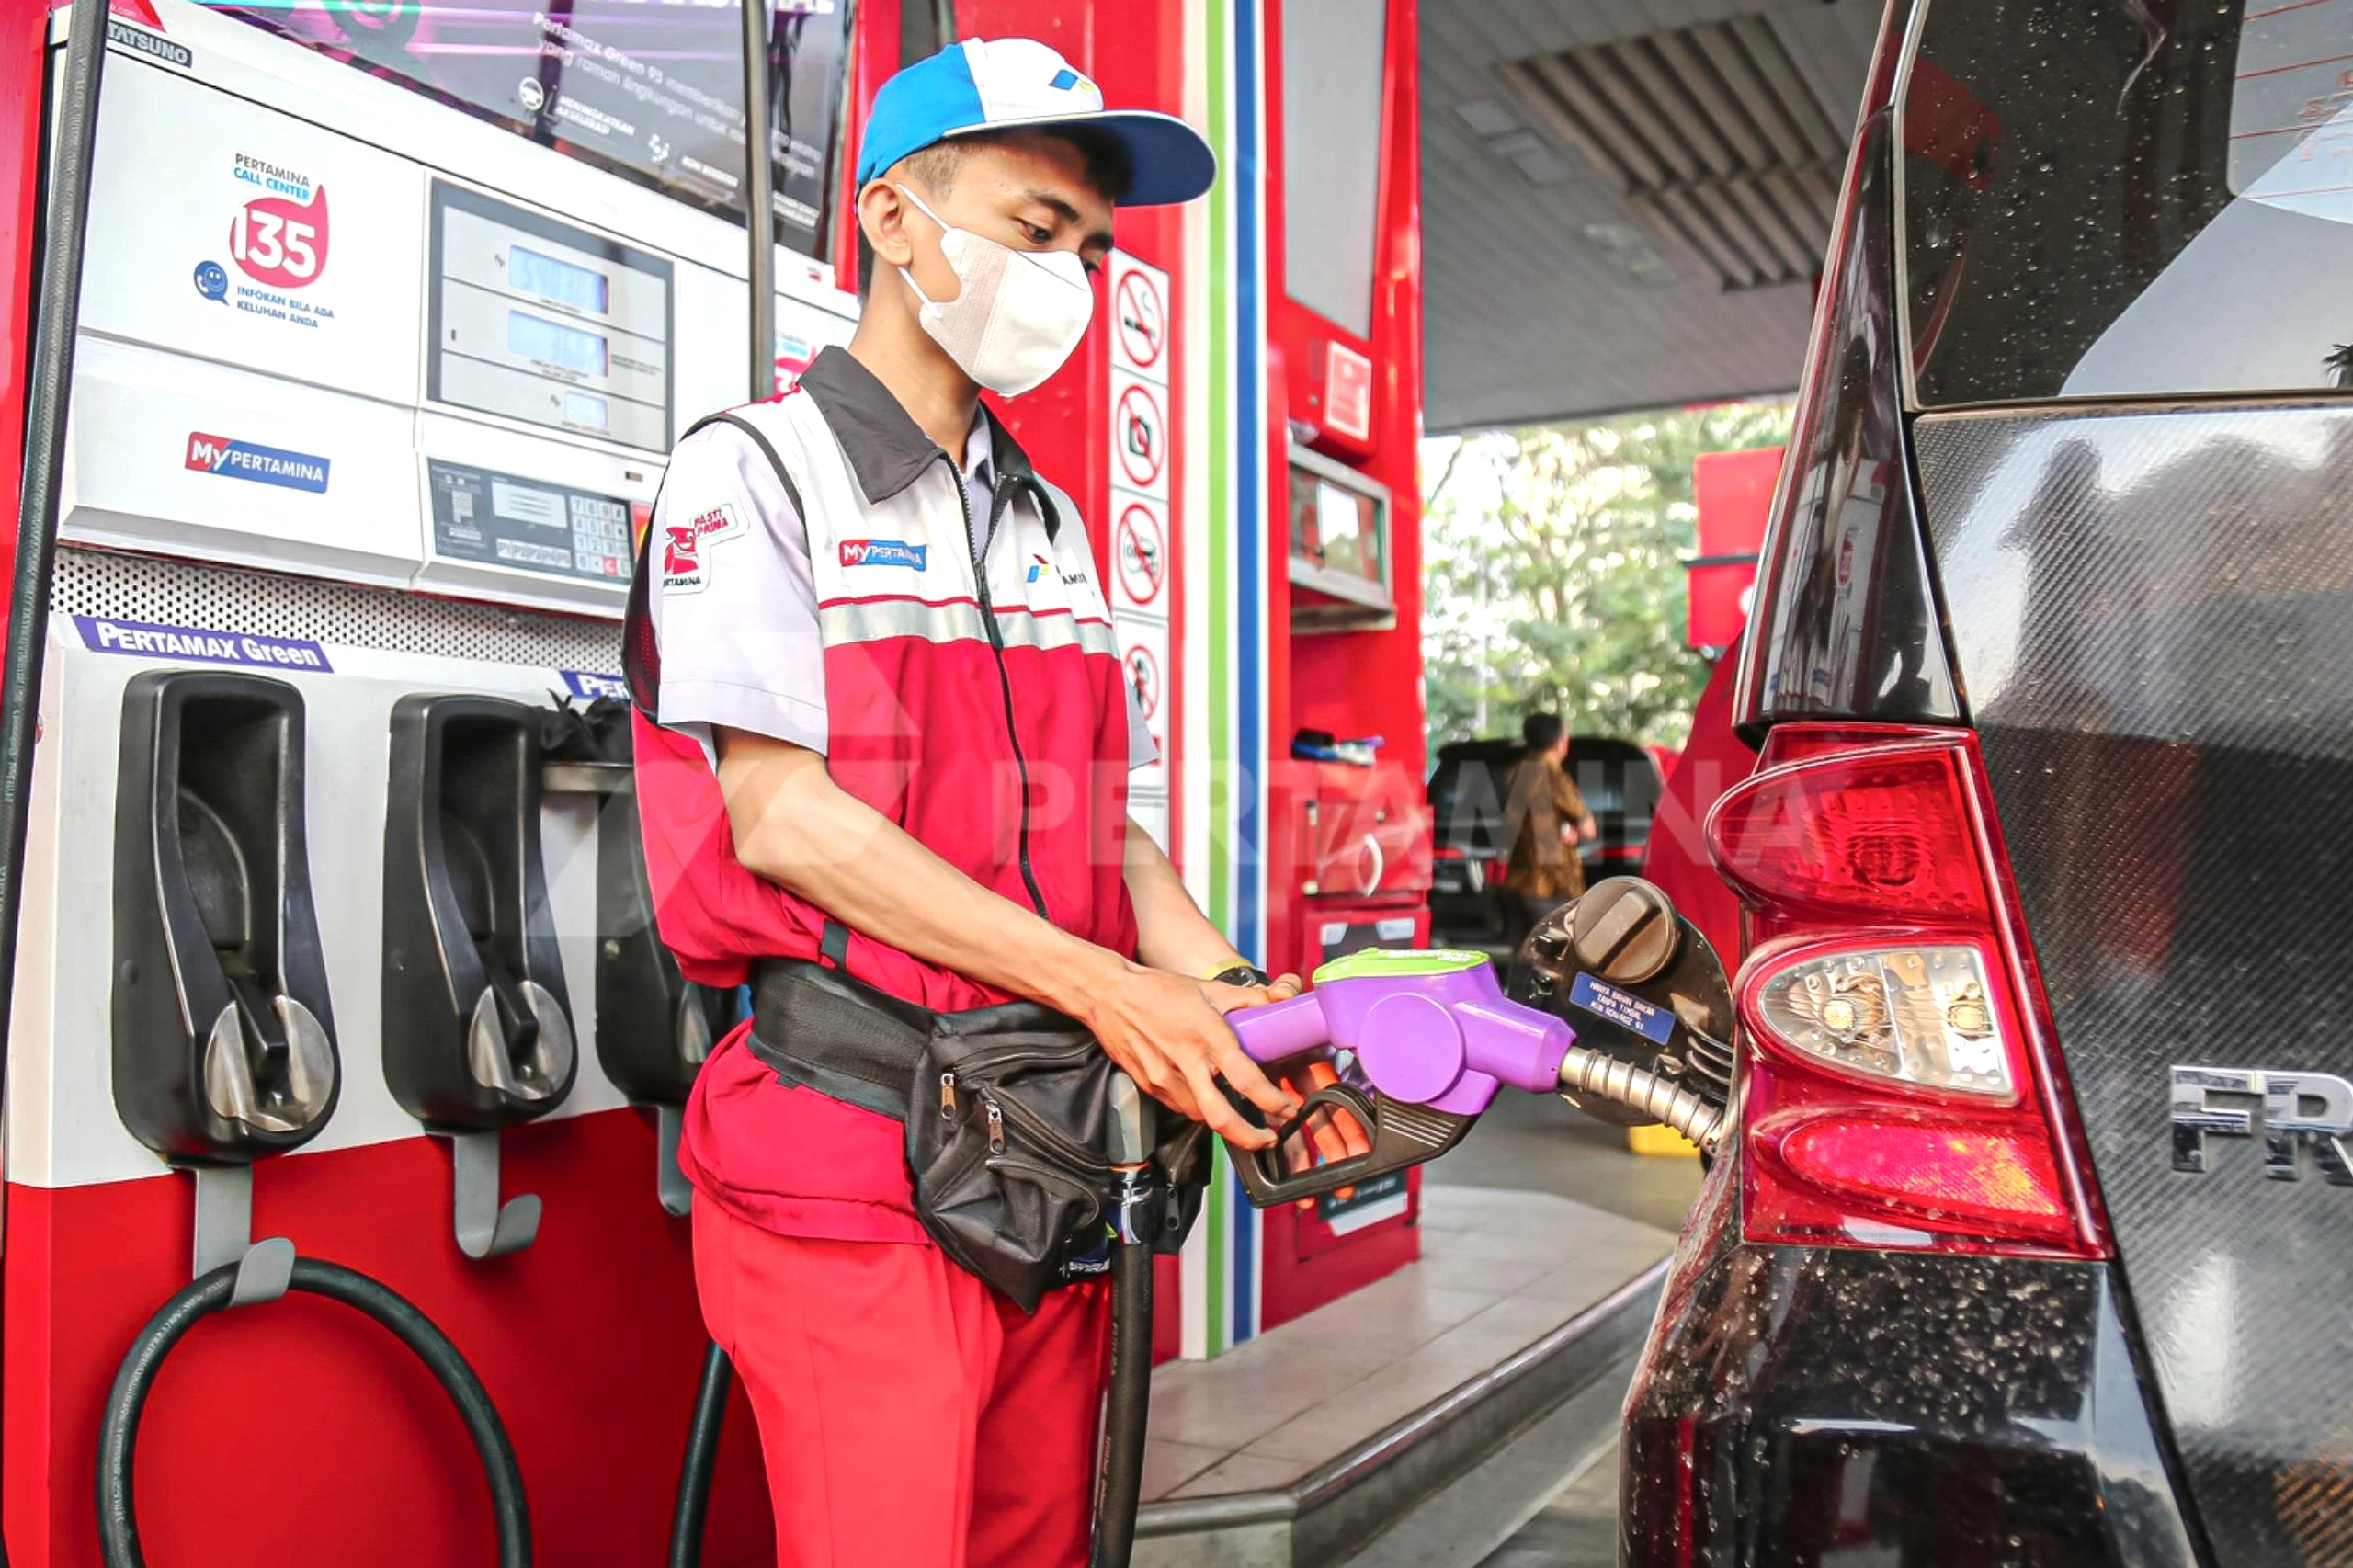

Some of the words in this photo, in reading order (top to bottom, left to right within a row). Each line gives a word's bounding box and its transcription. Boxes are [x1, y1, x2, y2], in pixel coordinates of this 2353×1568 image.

[108, 22, 188, 64] TATSUNO
[603, 46, 645, 76] Green
[647, 65, 664, 85] 95
[233, 167, 263, 186] CALL
[266, 177, 310, 201] CENTER
[235, 153, 310, 188] PERTAMINA
[234, 207, 317, 278] 135
[236, 285, 287, 307] INFOKAN
[289, 299, 312, 313] BILA
[313, 305, 335, 319] ADA
[236, 300, 287, 321] KELUHAN
[289, 313, 319, 329] ANDA
[695, 508, 722, 528] PASTI
[697, 517, 729, 538] PRIMA
[95, 621, 242, 661] PERTAMAX
[240, 638, 321, 667] Green
